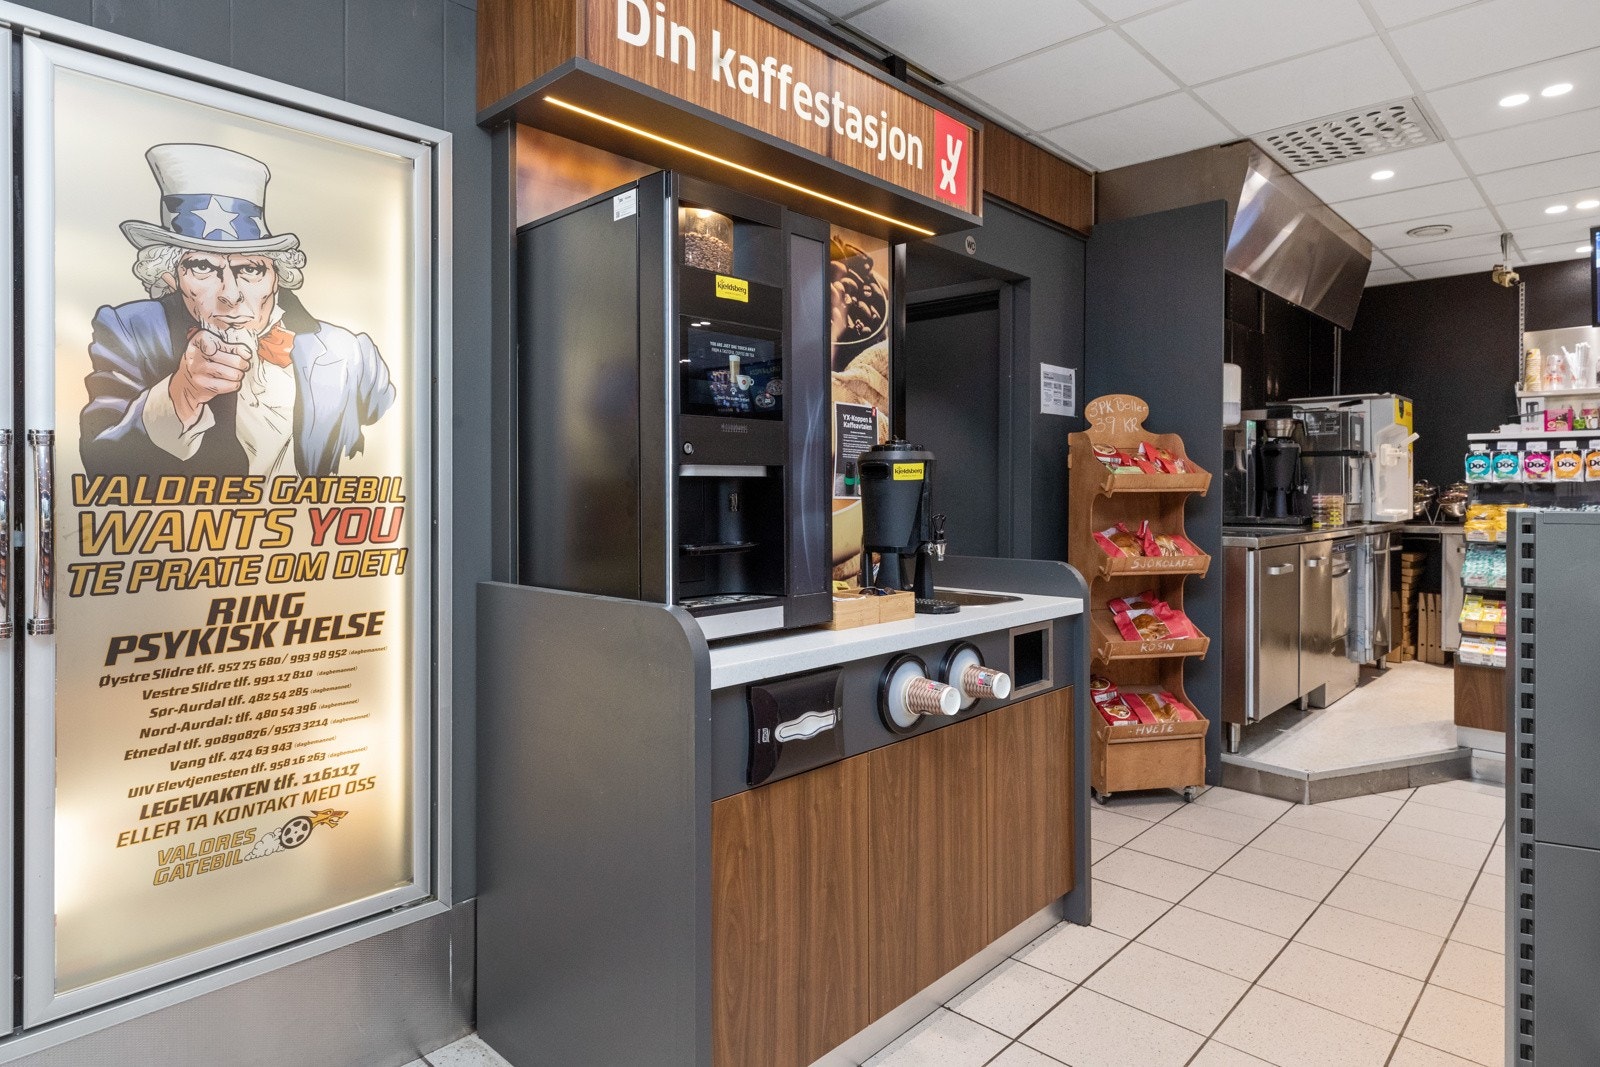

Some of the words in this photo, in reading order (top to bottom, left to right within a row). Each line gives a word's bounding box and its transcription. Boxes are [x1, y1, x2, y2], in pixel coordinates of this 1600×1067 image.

[617, 0, 696, 71] Din
[712, 30, 923, 169] kaffestasjon
[717, 280, 747, 295] kjeldsberg
[71, 473, 266, 506] VALDRES
[268, 475, 406, 504] GATEBIL
[78, 508, 297, 556] WANTS
[308, 506, 404, 546] YOU
[68, 561, 124, 597] TE
[126, 555, 264, 594] PRATE
[266, 551, 328, 584] OM
[333, 547, 408, 580] DET!
[206, 592, 306, 626] RING
[104, 620, 282, 666] PSYKISK
[282, 610, 386, 652] HELSE
[99, 671, 150, 688] Øystre
[152, 665, 194, 680] Slidre
[197, 664, 215, 677] tlf.
[218, 661, 242, 673] 957
[242, 659, 257, 670] 75
[290, 652, 311, 664] 993
[312, 650, 326, 662] 98
[328, 648, 348, 660] 952
[142, 688, 190, 700] Vestre
[191, 680, 232, 694] Slidre
[233, 676, 251, 688] tlf.
[254, 676, 275, 686] 991
[276, 674, 290, 683] 17
[292, 670, 314, 680] 810
[139, 714, 233, 739] Nord-Aurdal:
[234, 710, 253, 722] tlf.
[256, 709, 278, 722] 480
[280, 708, 294, 718] 54
[296, 702, 318, 715] 396
[149, 698, 226, 719] Sør-Aurdal
[227, 694, 246, 706] tlf.
[248, 692, 271, 704] 482
[272, 690, 286, 701] 54
[288, 687, 308, 697] 285
[124, 741, 182, 761] Etnedal
[183, 737, 202, 750] tlf.
[170, 756, 206, 772] Vang
[208, 750, 227, 764] tlf.
[230, 749, 253, 762] 474
[255, 745, 270, 756] 63
[270, 742, 293, 754] 943
[138, 778, 271, 821] LEGEVAKTEN
[272, 774, 299, 792] tlf.
[302, 762, 360, 786] 116117
[156, 768, 248, 794] Elevtjenesten
[250, 762, 268, 774] tlf.
[270, 758, 290, 772] 958
[292, 756, 306, 767] 16
[307, 752, 326, 764] 263
[116, 819, 180, 848] ELLER
[186, 814, 208, 832] TA
[212, 792, 300, 826] KONTAKT
[301, 782, 341, 803] MED
[344, 775, 377, 796] OSS
[157, 827, 257, 867] VALDRES
[152, 848, 244, 886] GATEBIL
